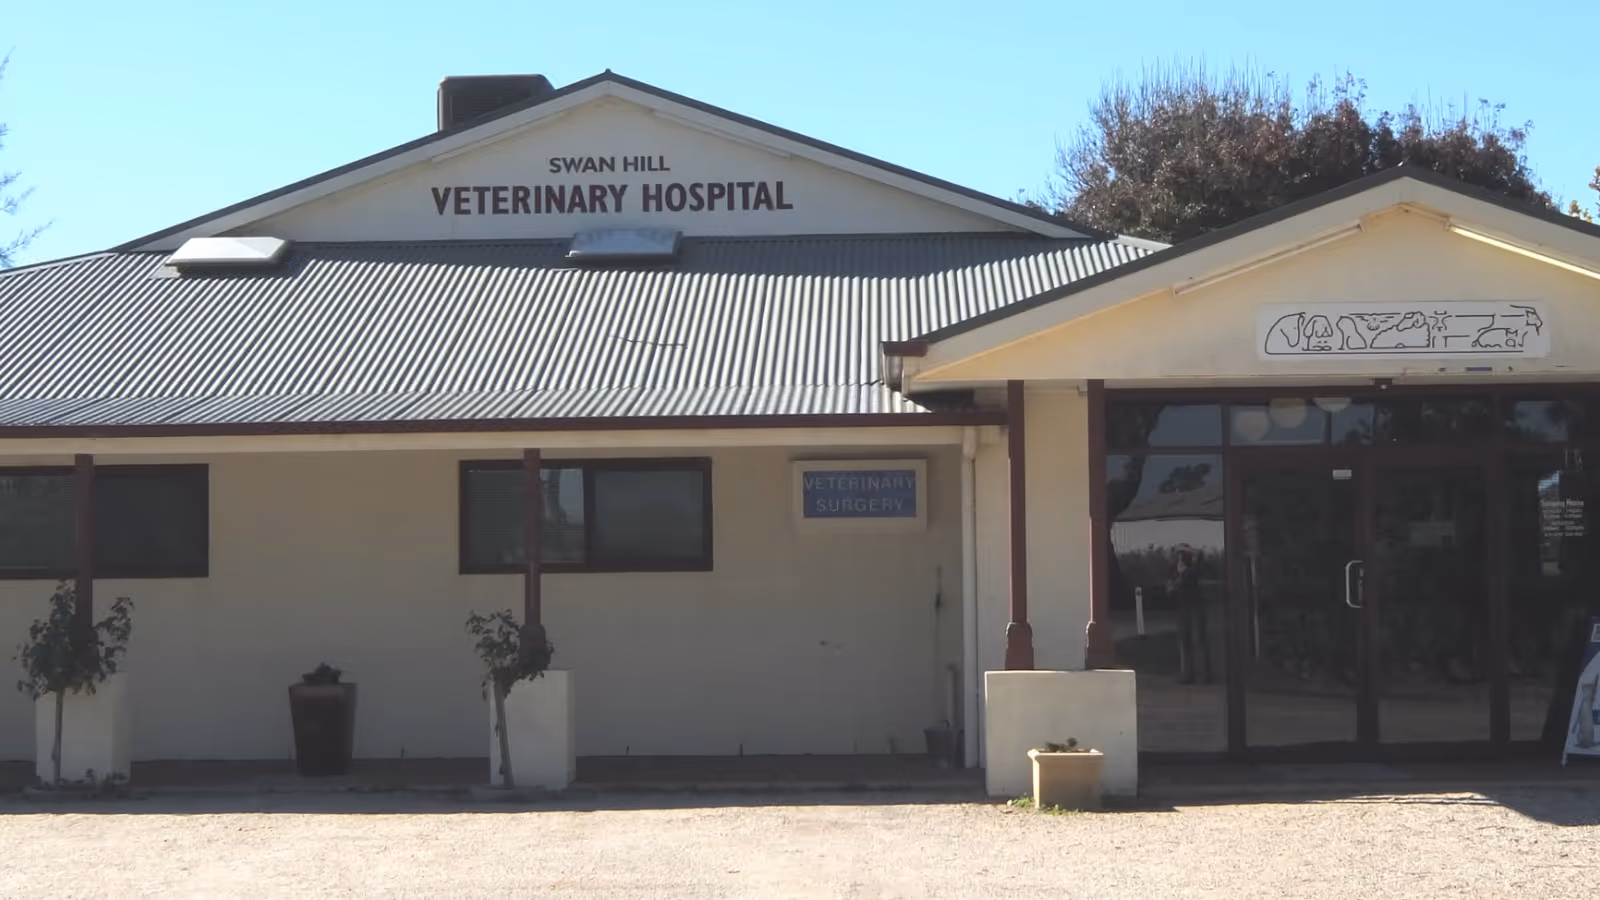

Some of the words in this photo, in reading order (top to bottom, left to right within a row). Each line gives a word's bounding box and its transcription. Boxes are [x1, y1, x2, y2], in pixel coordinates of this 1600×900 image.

[549, 156, 615, 173] SWAN
[623, 155, 670, 172] HILL
[431, 184, 628, 215] VETERINARY
[642, 181, 794, 212] HOSPITAL
[804, 476, 914, 490] VETERINARY
[816, 498, 904, 512] SURGERY
